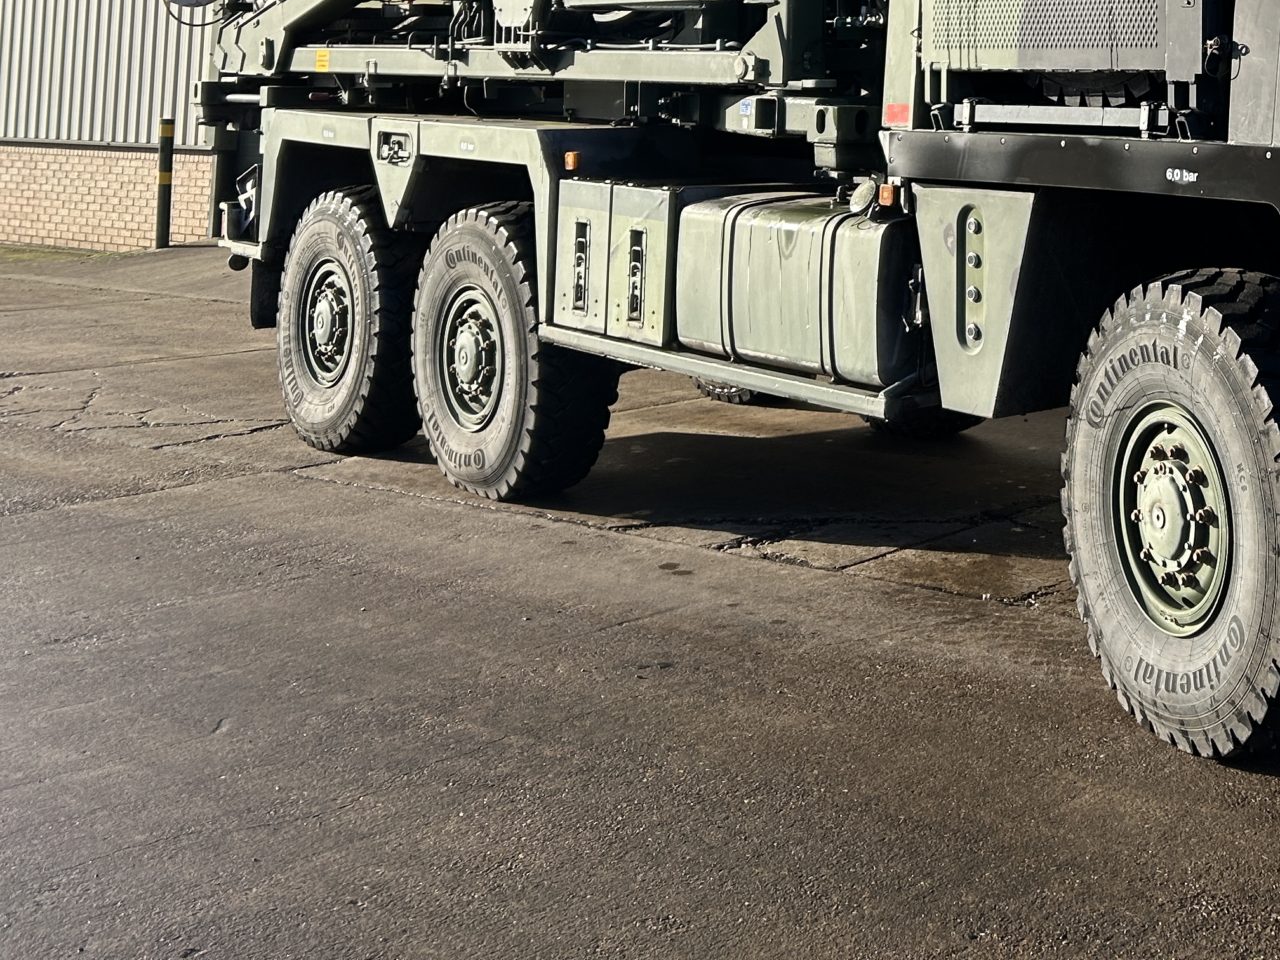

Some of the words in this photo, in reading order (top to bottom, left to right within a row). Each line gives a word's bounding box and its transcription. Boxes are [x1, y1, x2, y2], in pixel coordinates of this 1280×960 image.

[1183, 169, 1198, 182] bar
[445, 244, 504, 300] Continental
[1085, 336, 1180, 429] Continental
[427, 411, 486, 471] Continental
[1133, 614, 1245, 696] Continental
